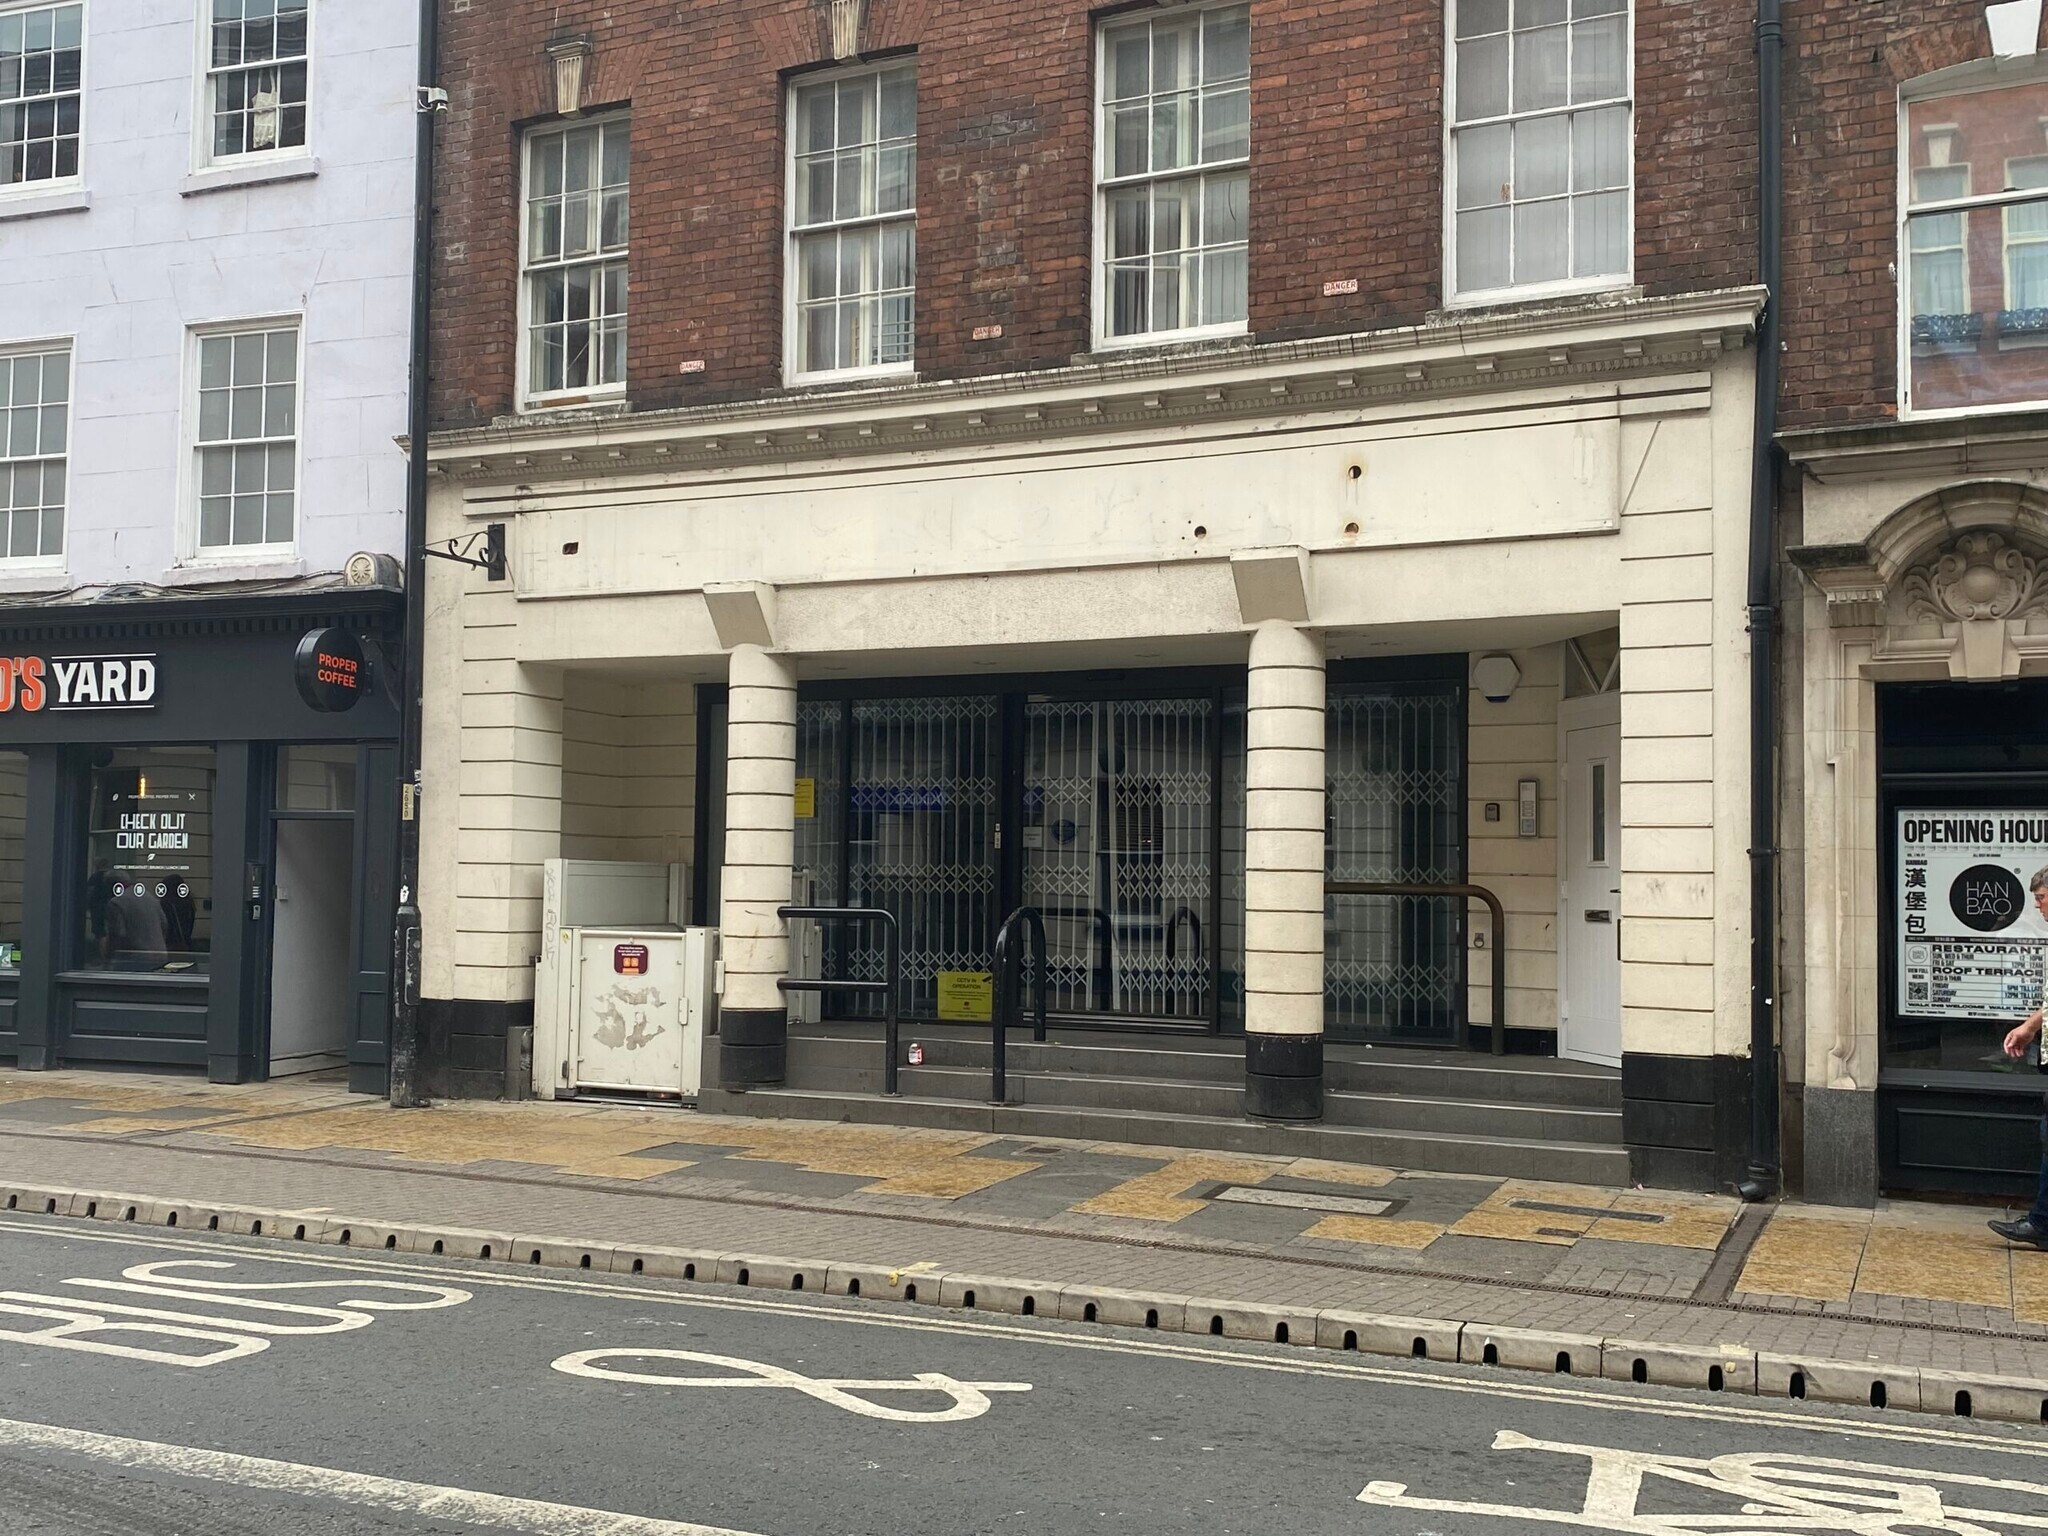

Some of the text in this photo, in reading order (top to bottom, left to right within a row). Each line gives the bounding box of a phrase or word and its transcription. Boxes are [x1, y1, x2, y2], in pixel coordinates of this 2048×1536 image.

[1325, 280, 1356, 291] DANGER
[319, 652, 358, 673] PROPER
[51, 660, 156, 703] YARD
[120, 813, 186, 830] CHECK OUT
[1904, 819, 1994, 844] OPENING
[116, 832, 189, 849] OUR GARDEN
[1966, 881, 2009, 898] HAN
[1904, 867, 1927, 934] 漢堡包
[1966, 898, 2012, 915] BAO
[1932, 945, 2043, 955] RESTAURANT
[1976, 968, 2043, 976] TERRACE
[0, 1260, 473, 1368] BUS
